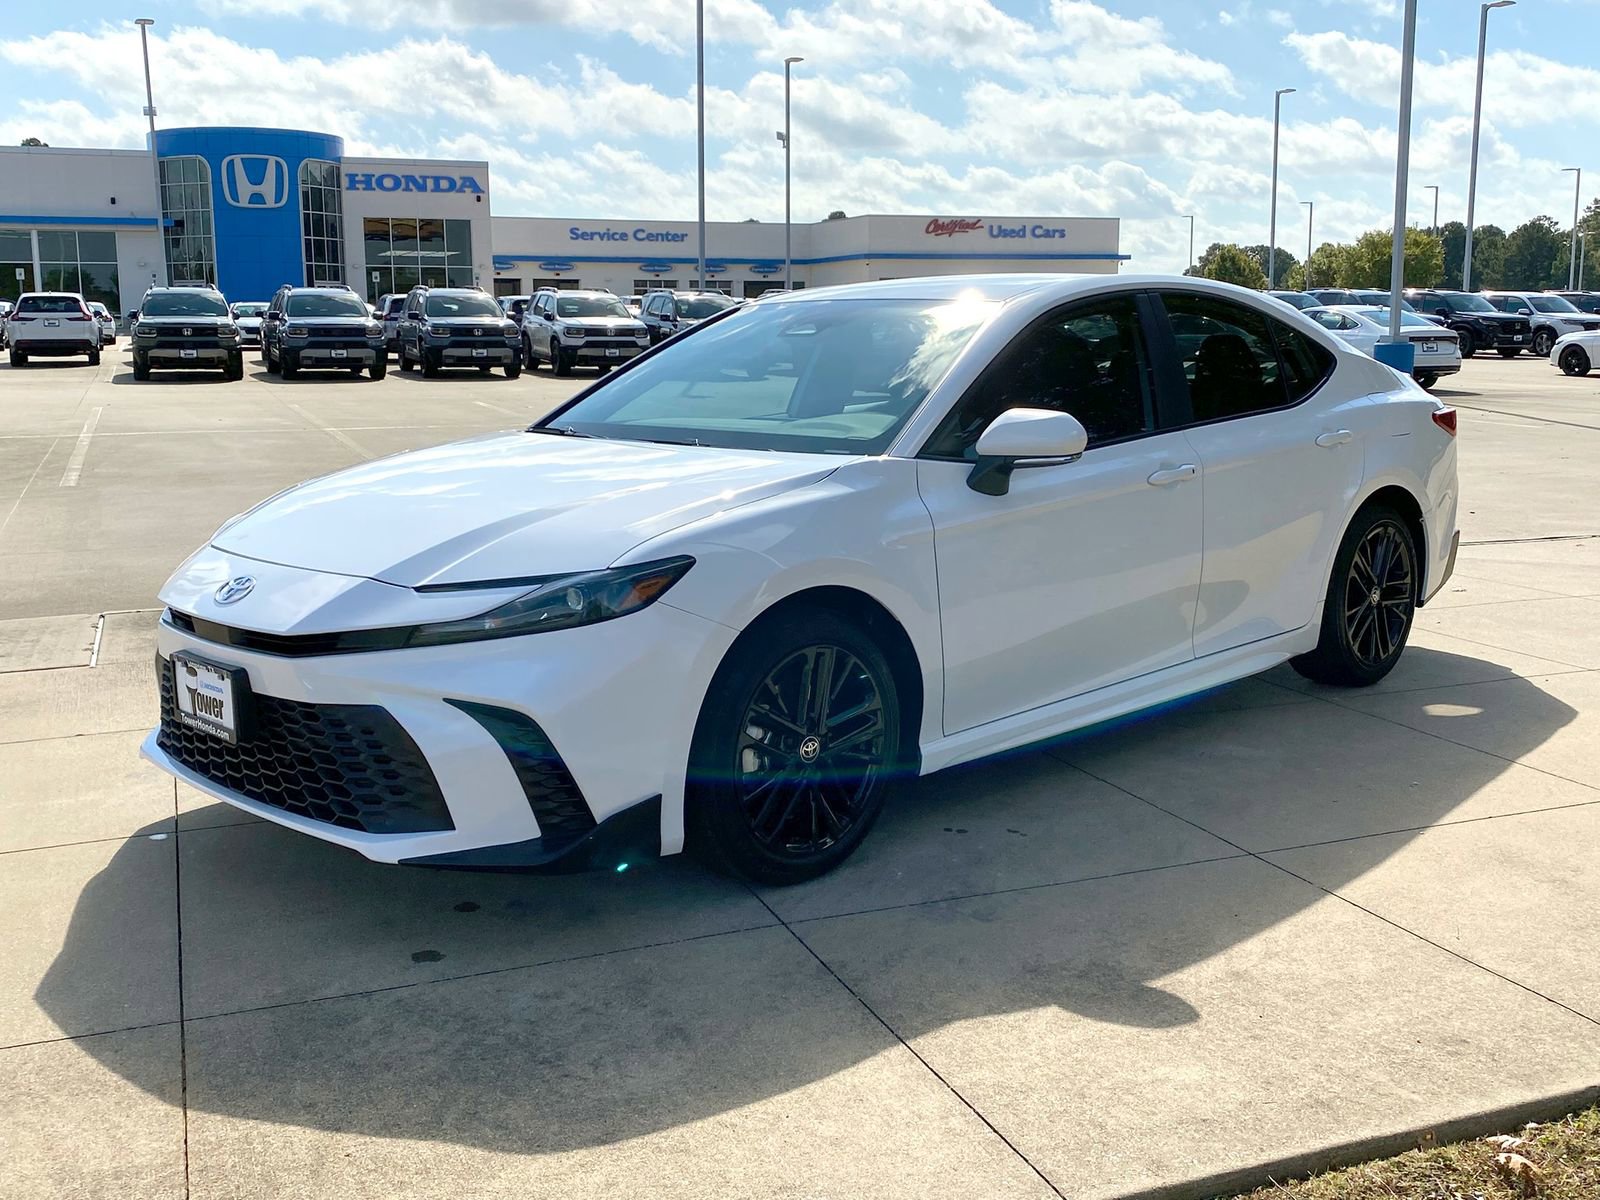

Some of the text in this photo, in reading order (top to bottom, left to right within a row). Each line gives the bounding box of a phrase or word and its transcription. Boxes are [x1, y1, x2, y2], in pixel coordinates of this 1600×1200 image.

[345, 173, 485, 194] HONDA
[569, 227, 688, 243] Service Center
[925, 218, 1066, 239] Certified Used Cars
[186, 684, 224, 720] Tower
[181, 712, 230, 741] TowerHonda.com
